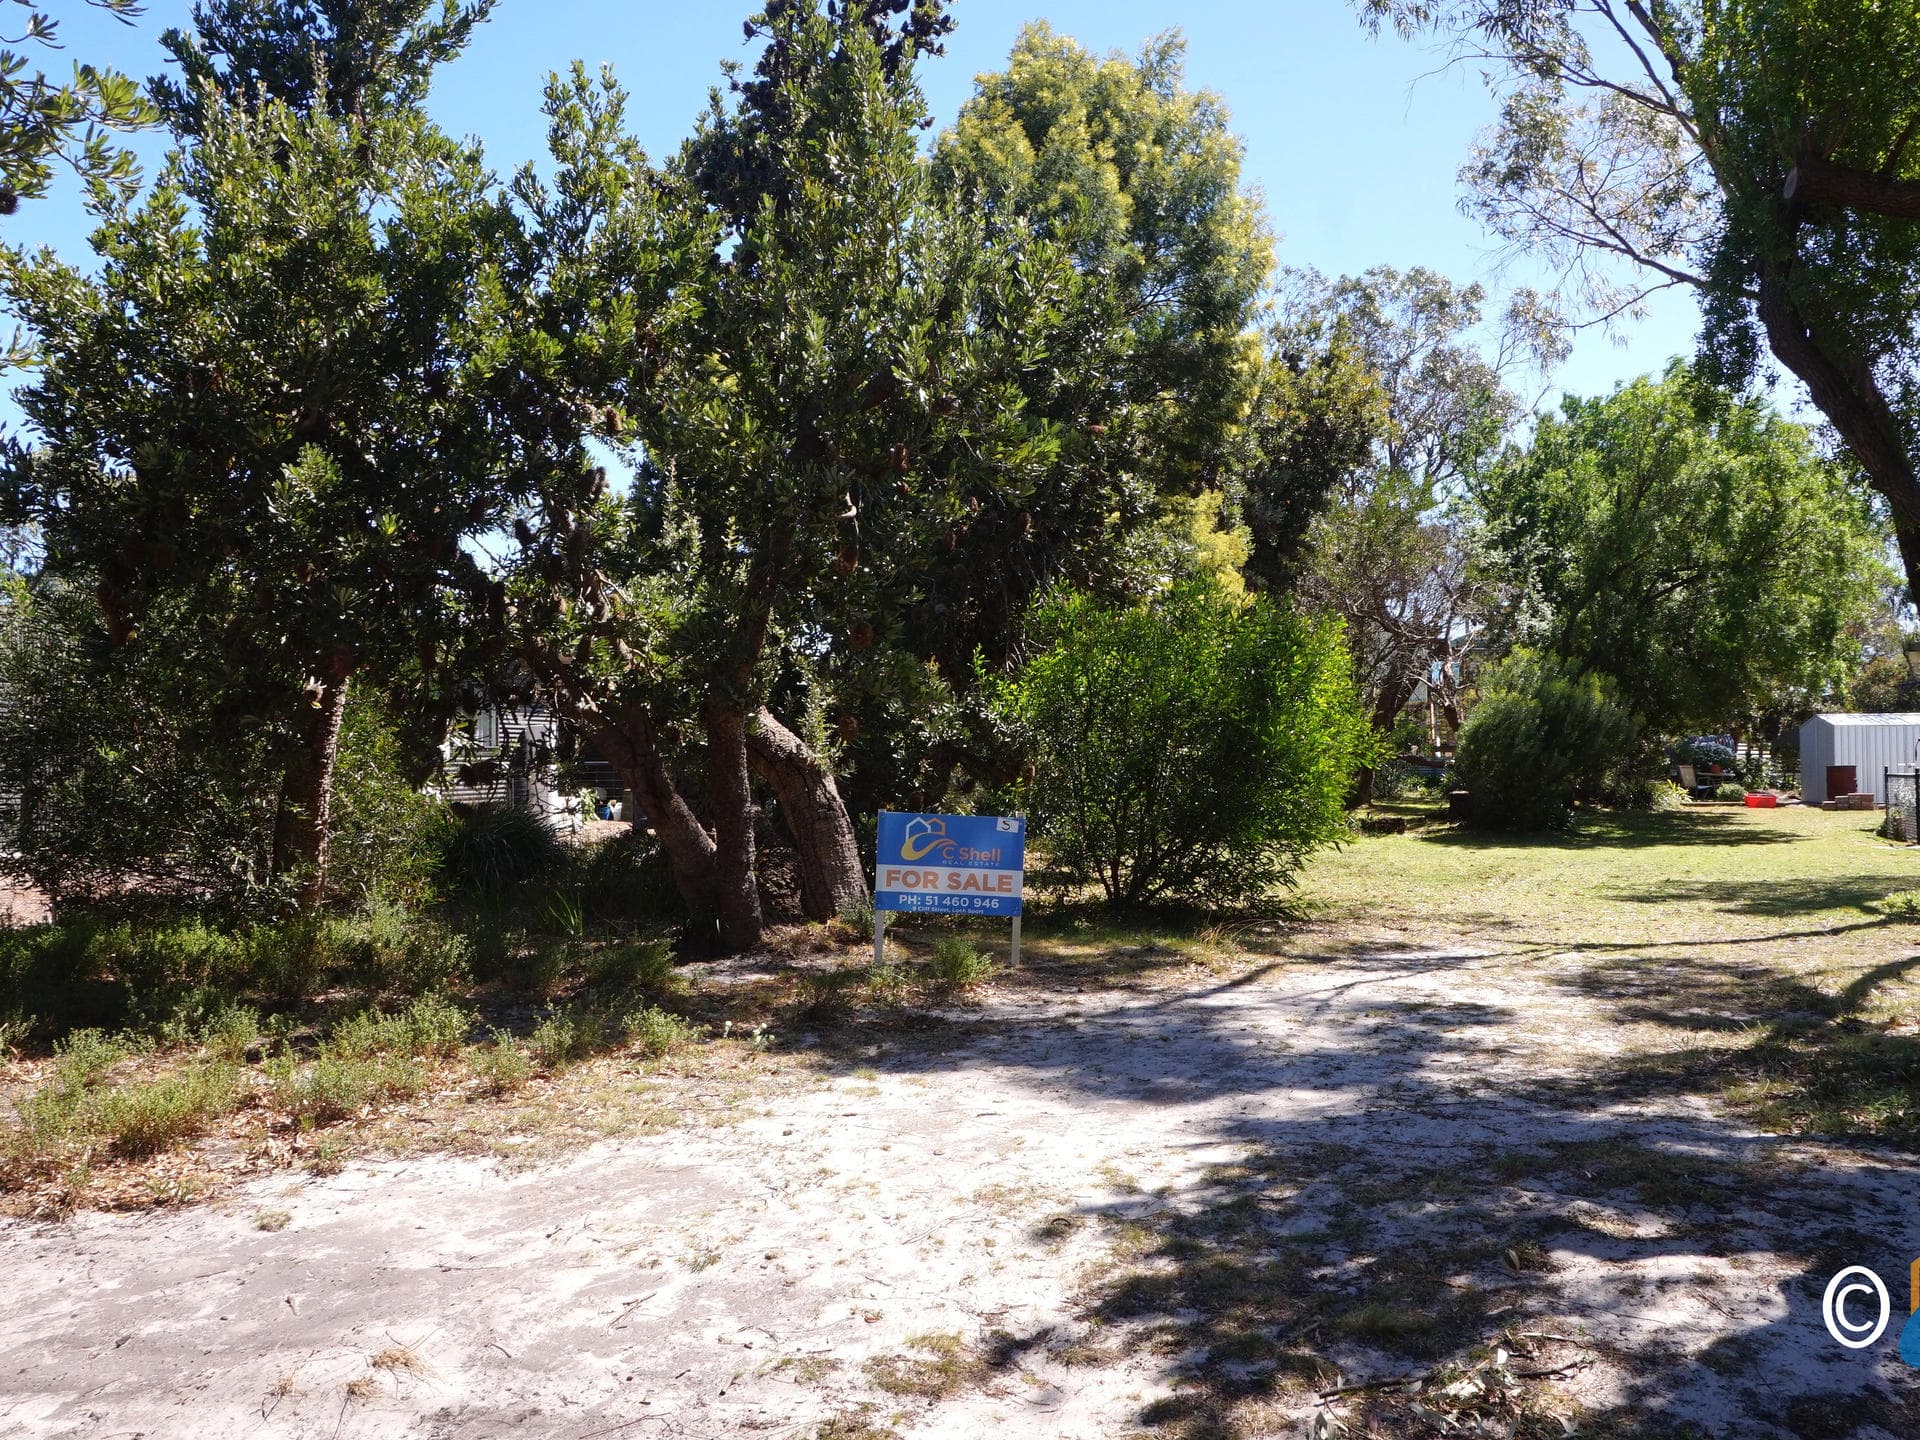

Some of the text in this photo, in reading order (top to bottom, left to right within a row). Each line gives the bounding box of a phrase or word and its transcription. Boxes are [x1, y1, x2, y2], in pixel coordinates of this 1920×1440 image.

[942, 847, 1001, 861] C Shell
[885, 869, 1013, 893] FOR SALE
[899, 894, 1000, 909] PH: 51 460 946
